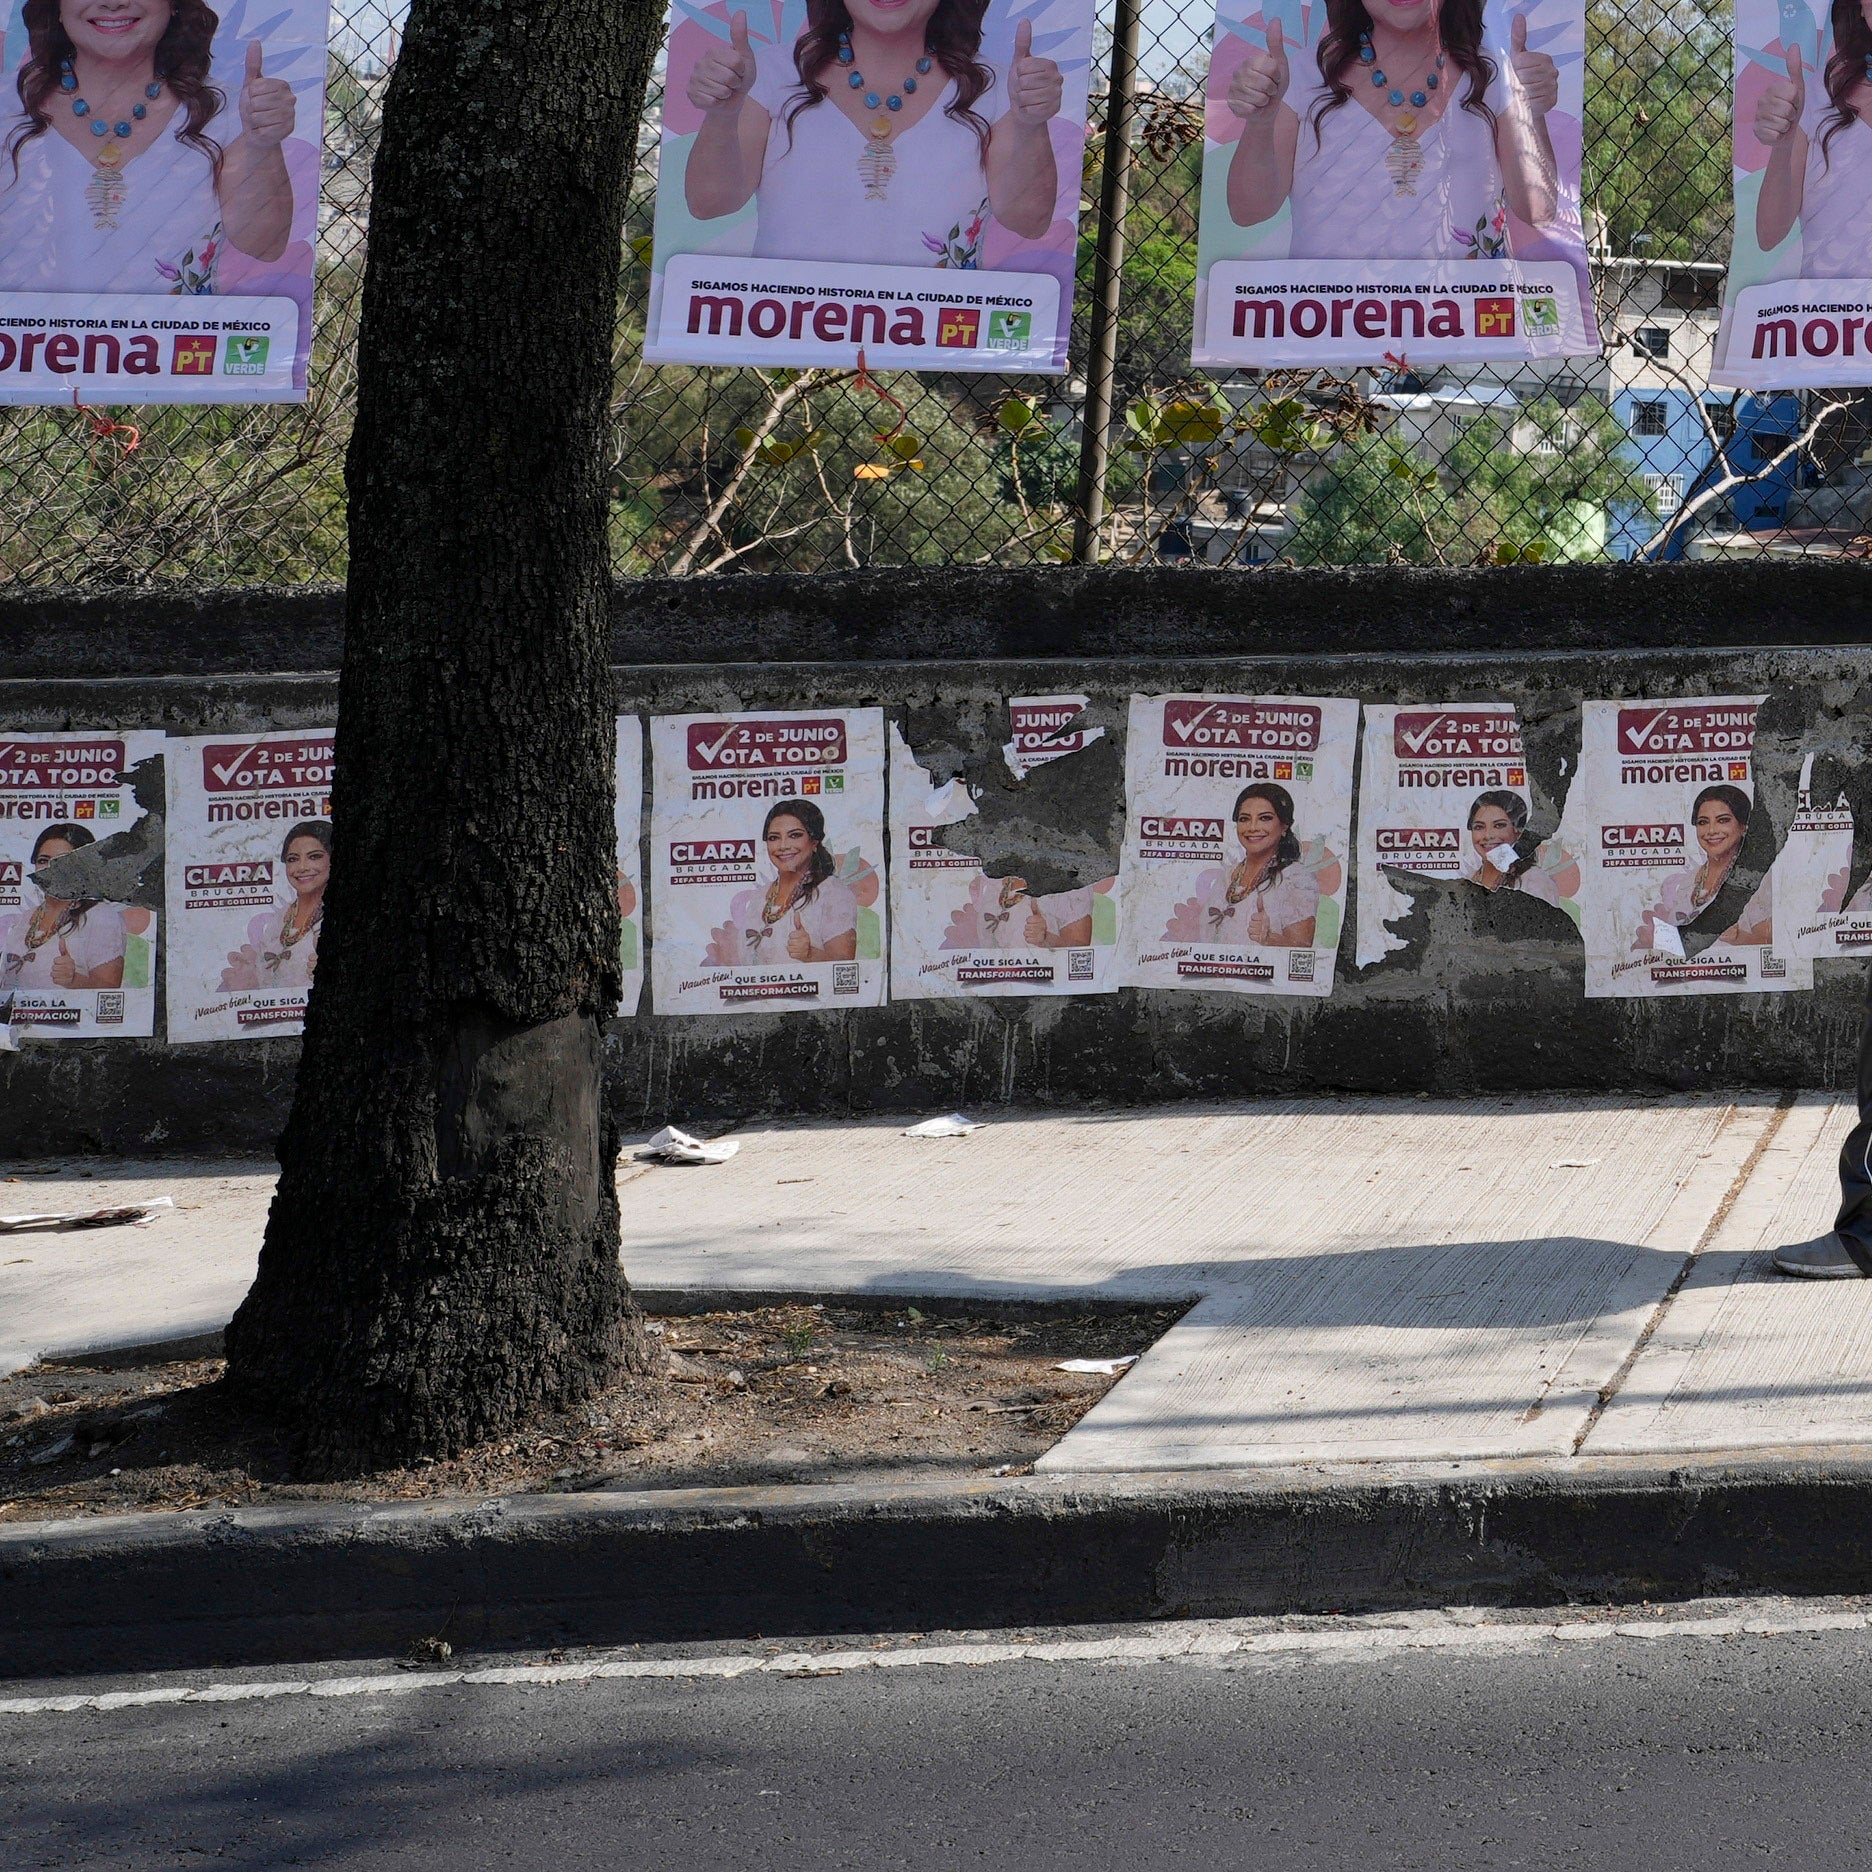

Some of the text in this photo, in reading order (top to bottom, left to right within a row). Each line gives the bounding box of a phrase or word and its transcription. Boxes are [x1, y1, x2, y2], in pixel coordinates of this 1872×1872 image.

[691, 280, 1033, 308] SIGAMOS HACIENDO HISTORIA EN LA CIUDAD DE MÉXICO
[686, 293, 928, 347] morena
[1233, 299, 1465, 339] morena
[1478, 313, 1511, 336] PT
[940, 323, 976, 346] PT
[988, 337, 1029, 352] VERDE
[176, 350, 213, 372] PT
[225, 363, 267, 376] VERDE
[739, 726, 839, 746] 2 DE JUNIO
[772, 744, 840, 763] TODO
[1163, 755, 1270, 781] morena
[1619, 761, 1724, 784] morena
[691, 776, 797, 801] morena
[803, 783, 819, 793] PT
[1142, 819, 1223, 840] CLARA
[1603, 827, 1683, 845] CLARA
[672, 843, 753, 863] CLARA
[186, 865, 271, 886] CLARA
[1179, 962, 1273, 978] TRANSFORMACIÓN
[721, 983, 816, 997] TRANSFORMACIÓN
